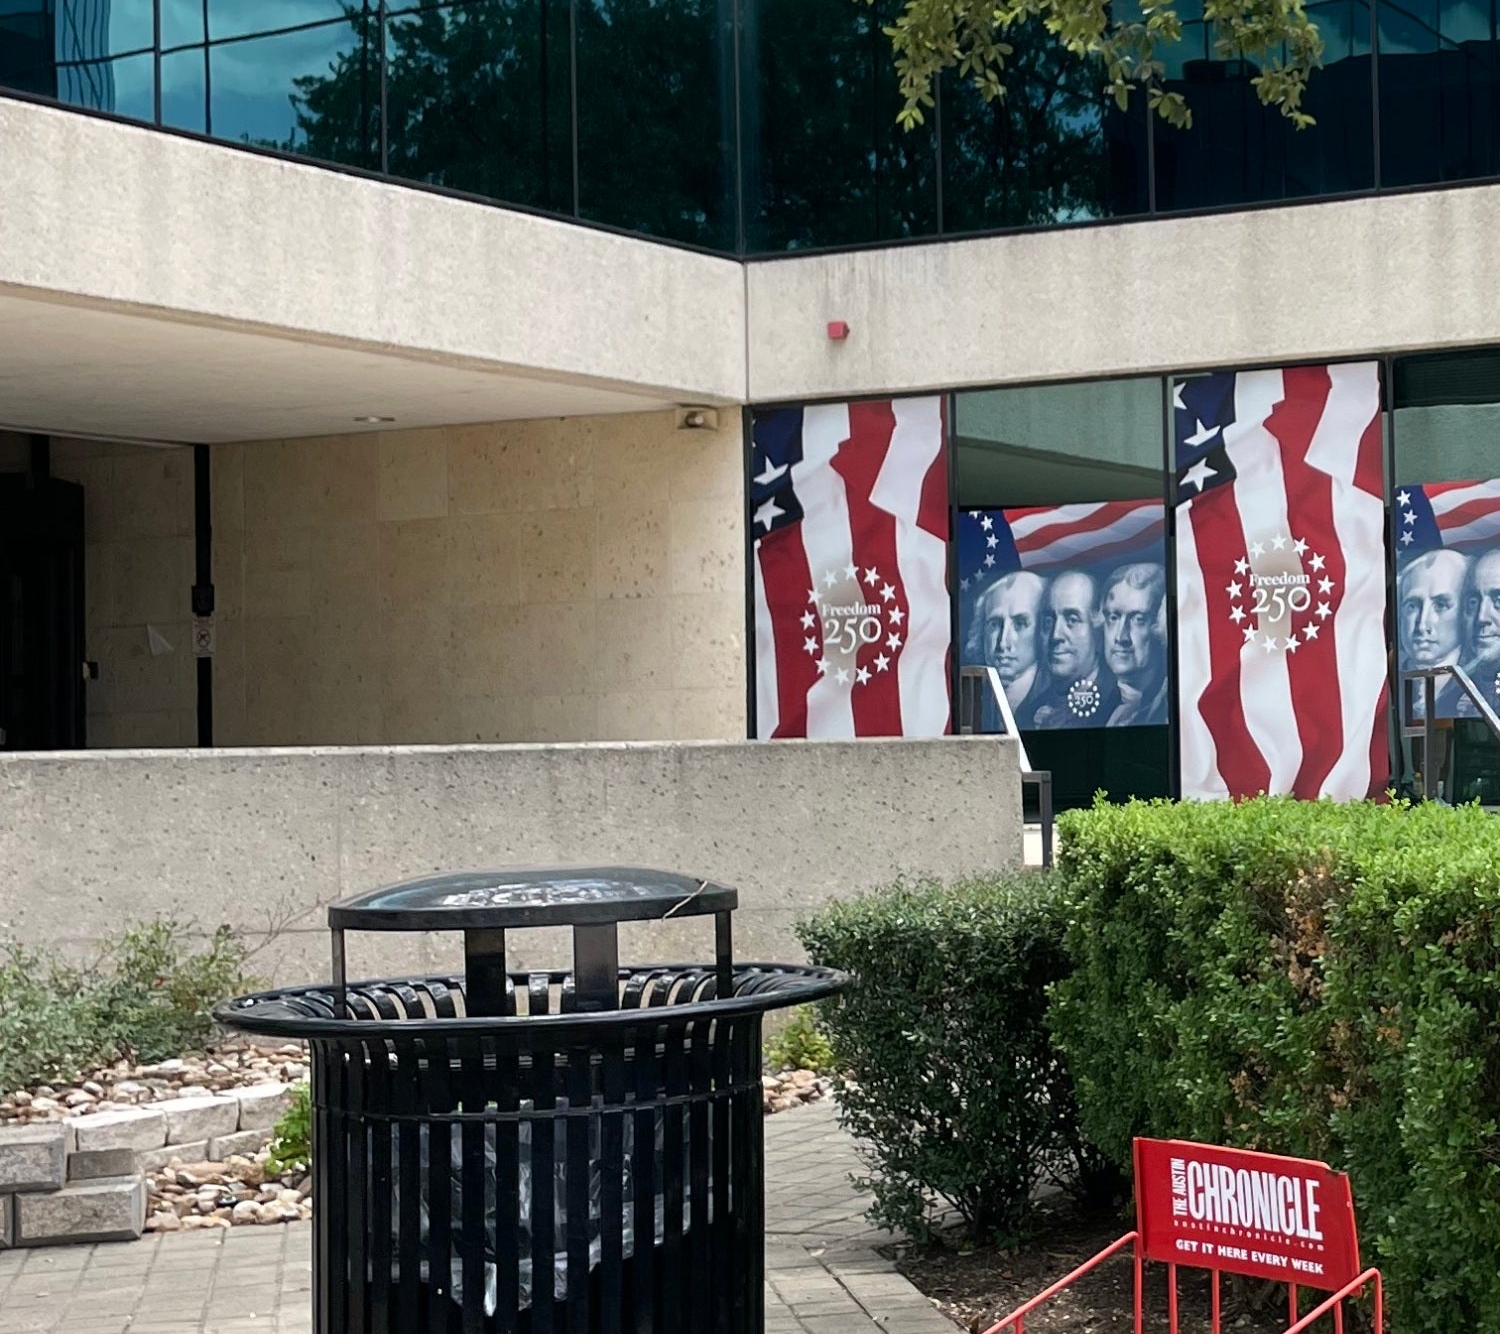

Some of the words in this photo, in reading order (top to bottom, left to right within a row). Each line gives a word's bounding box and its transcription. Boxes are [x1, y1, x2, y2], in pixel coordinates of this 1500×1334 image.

[1249, 571, 1311, 587] Freedom
[821, 601, 882, 617] Freedom
[1250, 586, 1311, 623] 250
[824, 616, 882, 654] 250
[1074, 695, 1094, 707] 250
[1171, 1158, 1187, 1196] AUSTIN
[1173, 1197, 1187, 1216] THE
[1187, 1161, 1323, 1241] CHRONICLE
[1176, 1239, 1199, 1252] GET
[1202, 1242, 1214, 1255] IT
[1217, 1245, 1248, 1261] HERE
[1251, 1250, 1288, 1268] EVERY
[1291, 1258, 1324, 1275] WEEK
